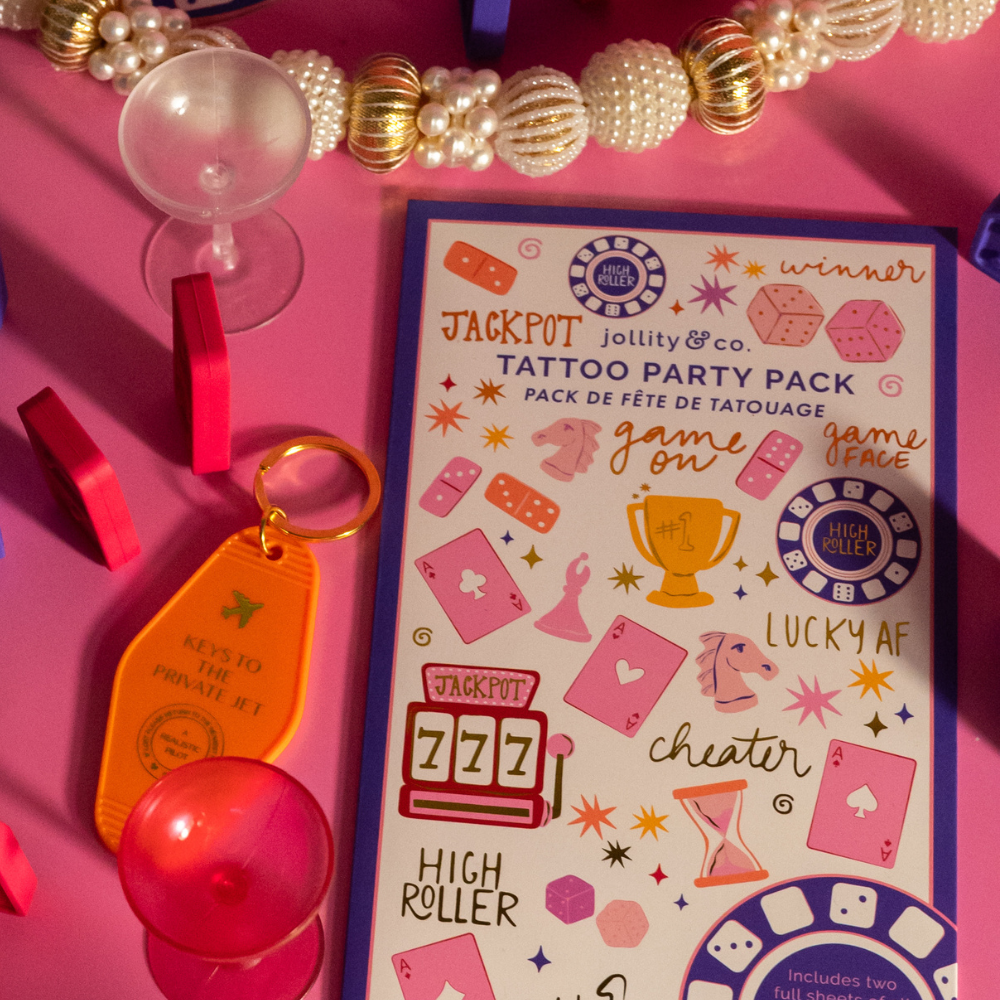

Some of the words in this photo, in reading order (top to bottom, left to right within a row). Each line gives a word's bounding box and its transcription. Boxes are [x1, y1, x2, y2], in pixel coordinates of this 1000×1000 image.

[597, 274, 635, 287] ROLLER
[603, 264, 630, 276] HIGH
[780, 256, 926, 283] winner
[441, 309, 583, 347] JACKPOT
[497, 354, 629, 381] TATTOO
[643, 362, 753, 388] PARTY
[766, 369, 855, 395] PACK
[524, 387, 578, 404] PACK
[586, 391, 613, 406] DE
[621, 389, 667, 408] FÊTE
[675, 395, 701, 411] DE
[709, 398, 825, 418] TATOUAGE
[610, 421, 747, 475] game
[823, 422, 927, 466] game
[843, 446, 911, 469] FACE
[650, 450, 718, 475] on
[654, 511, 695, 552] #1
[829, 522, 869, 541] HIGH
[822, 536, 877, 557] ROLLER
[422, 561, 433, 573] A
[615, 622, 626, 634] A
[766, 612, 865, 655] LUCKY
[876, 621, 910, 657] AF
[184, 634, 232, 663] KEYS
[237, 652, 262, 673] TO
[198, 660, 234, 685] THE
[152, 664, 229, 703] PRIVATE
[230, 696, 265, 716] JET
[435, 674, 526, 701] JACKPOT
[649, 722, 812, 778] cheater
[832, 746, 843, 761] A
[418, 847, 502, 890] HIGH
[401, 882, 519, 928] ROLLER
[400, 958, 411, 973] A
[774, 986, 801, 1000] full
[788, 969, 861, 987] Includes
[866, 976, 898, 991] two
